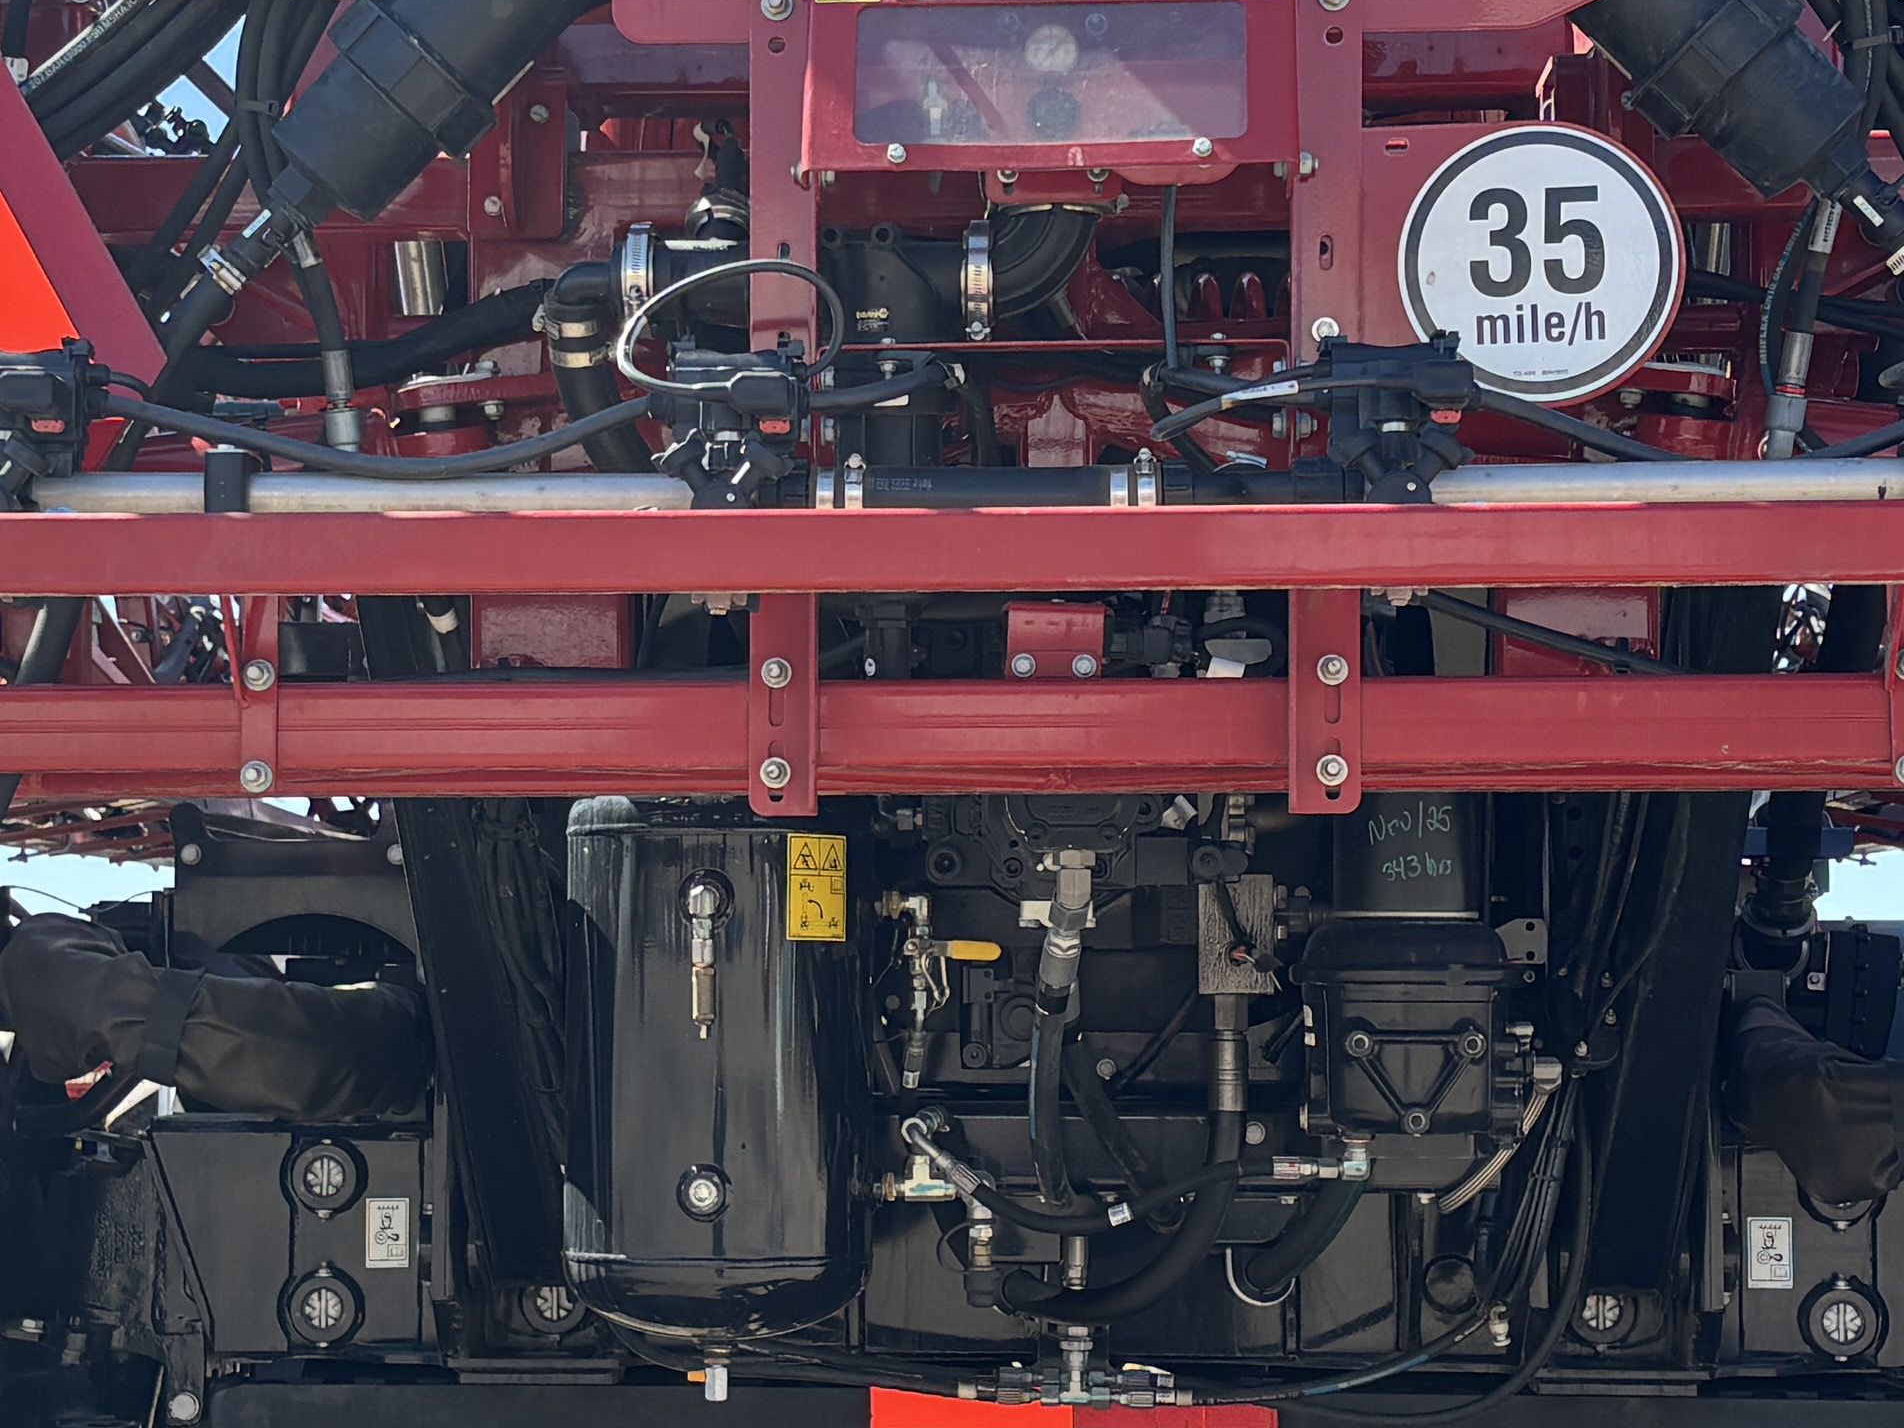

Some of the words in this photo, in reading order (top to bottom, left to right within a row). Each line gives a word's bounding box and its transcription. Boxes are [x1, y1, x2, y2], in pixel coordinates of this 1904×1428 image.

[1469, 185, 1606, 297] 35
[1476, 301, 1606, 346] mile/h
[1382, 854, 1421, 881] 343
